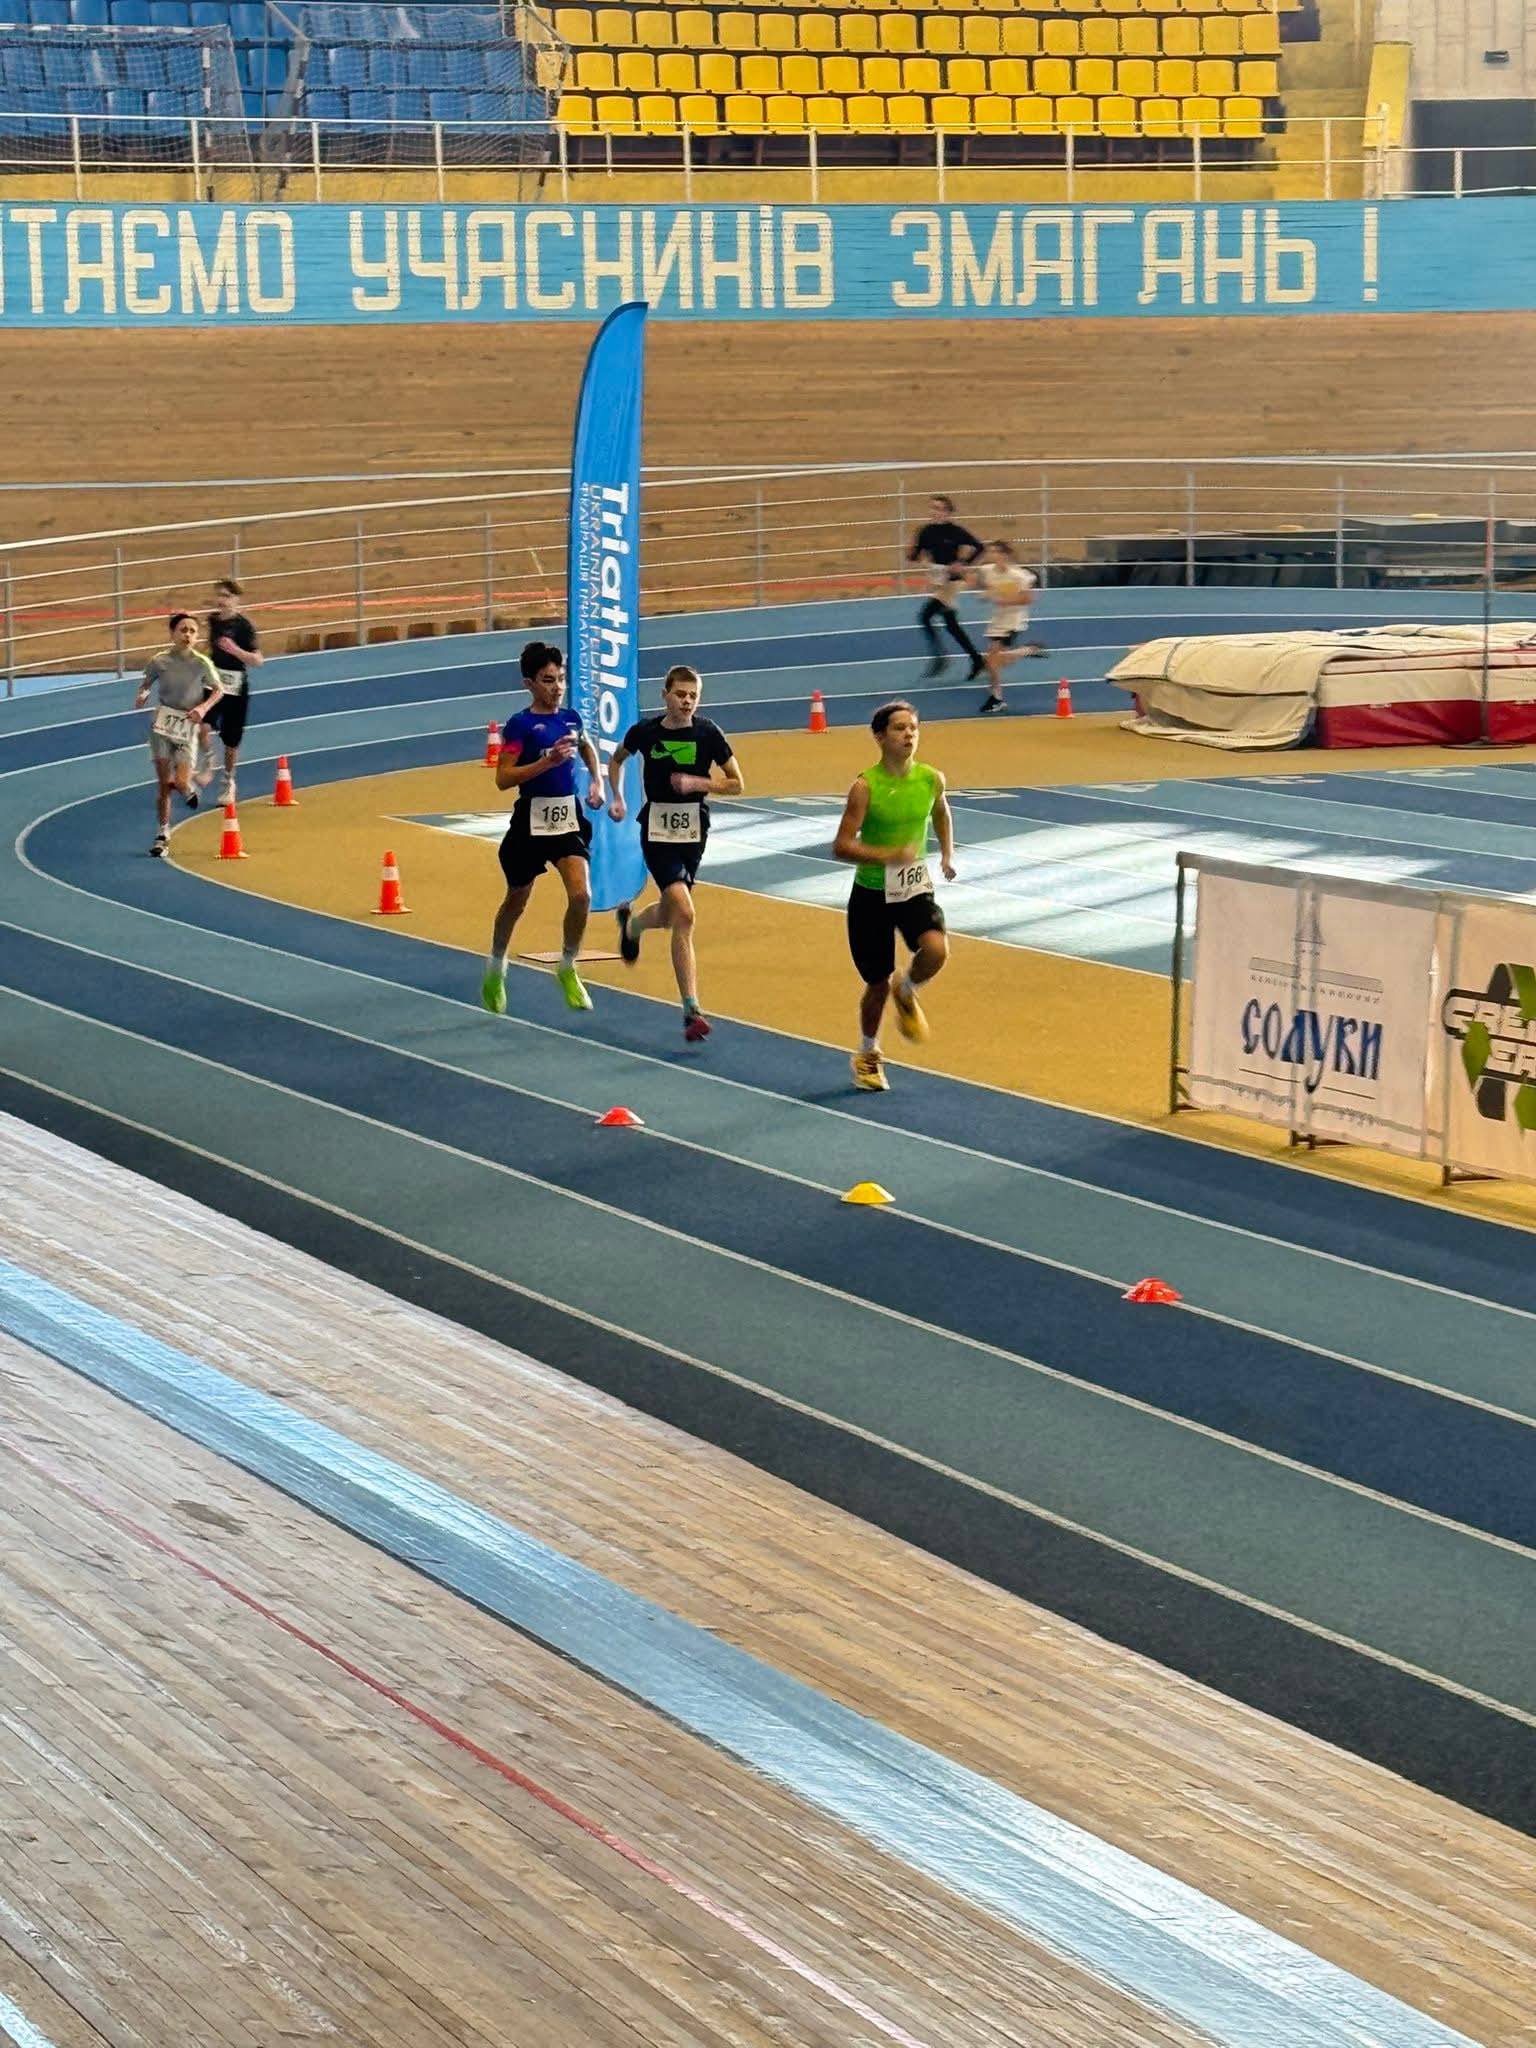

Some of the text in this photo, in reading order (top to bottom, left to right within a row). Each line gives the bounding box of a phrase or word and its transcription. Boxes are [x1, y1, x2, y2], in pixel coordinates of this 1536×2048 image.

[889, 208, 1318, 308] ЗМАГАНЬ
[589, 484, 601, 619] UKRAINIAN
[541, 805, 569, 823] 169
[660, 812, 690, 829] 168
